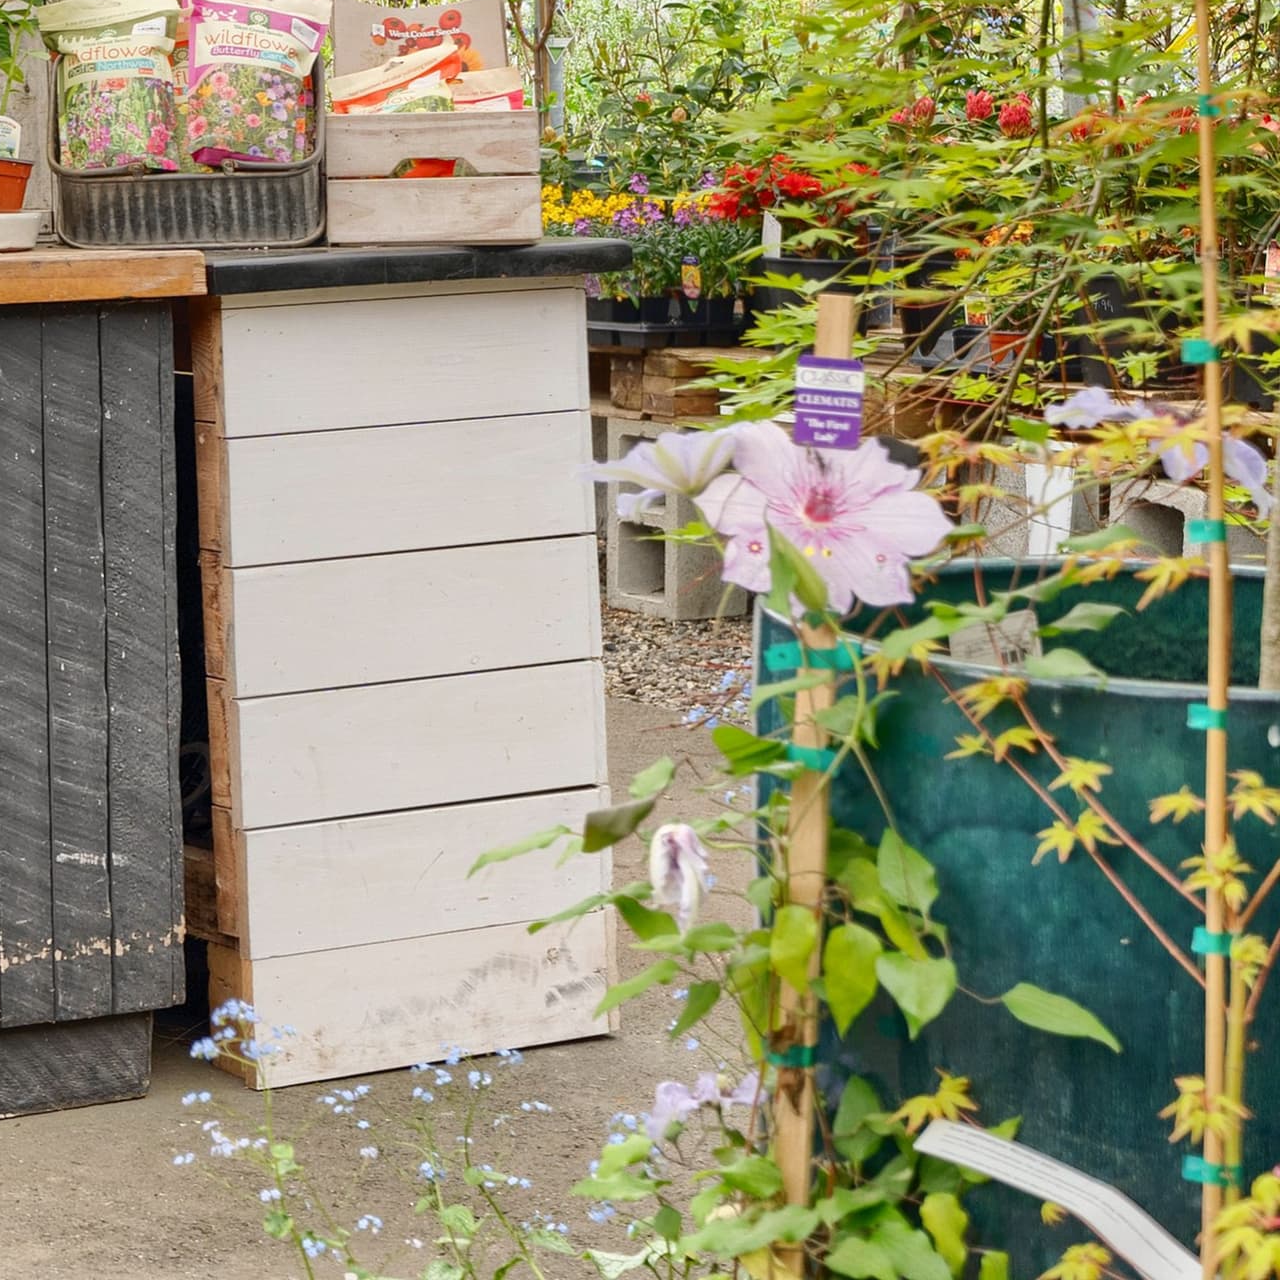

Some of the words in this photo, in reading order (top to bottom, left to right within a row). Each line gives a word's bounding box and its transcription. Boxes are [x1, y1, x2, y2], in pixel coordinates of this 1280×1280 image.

[389, 29, 411, 38] West
[411, 29, 435, 39] Coast
[436, 27, 462, 37] Seeds
[204, 28, 298, 59] wildflowe
[211, 45, 260, 59] Butterfly
[798, 394, 860, 409] CLEMATIS
